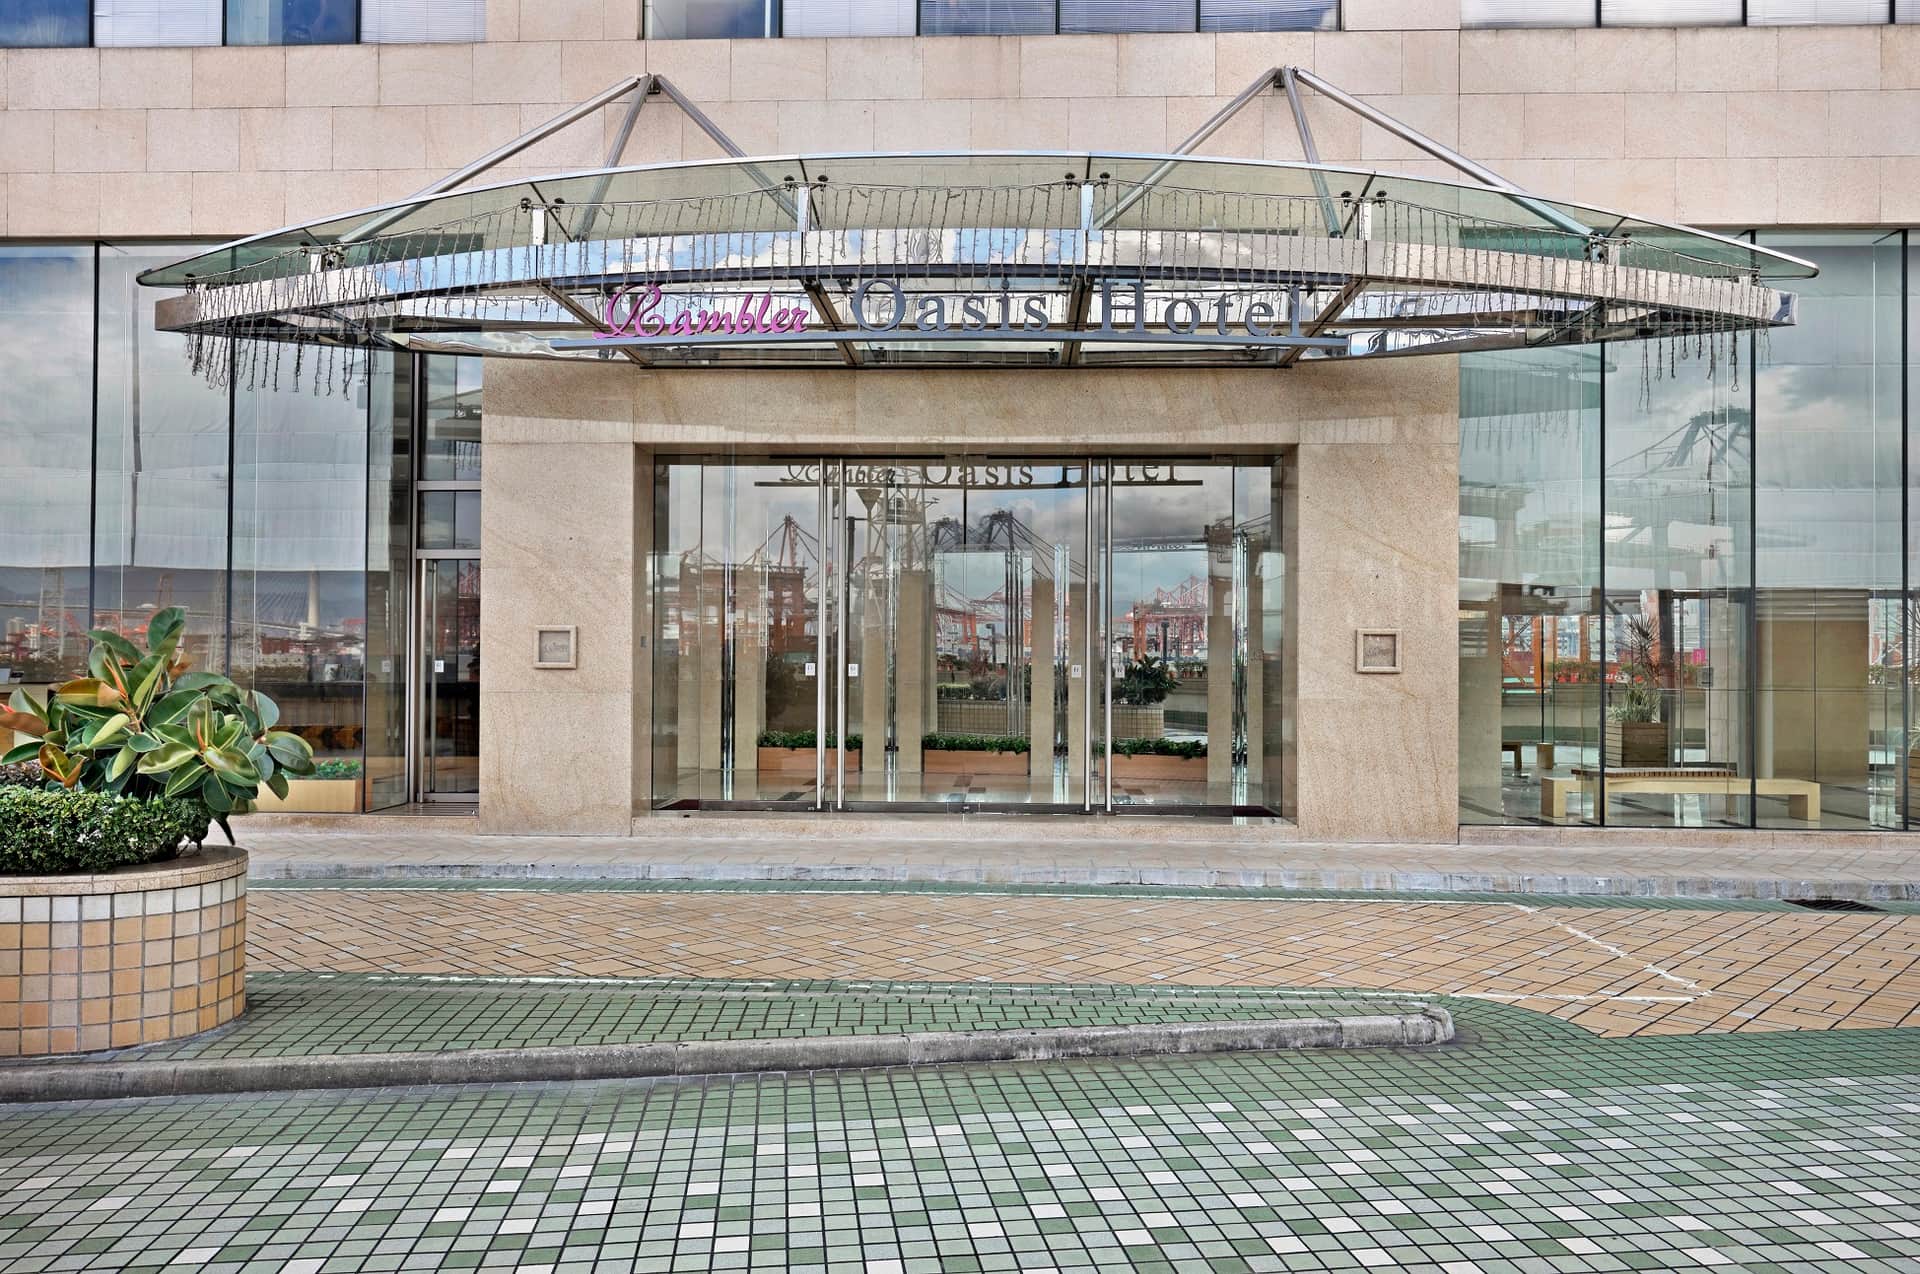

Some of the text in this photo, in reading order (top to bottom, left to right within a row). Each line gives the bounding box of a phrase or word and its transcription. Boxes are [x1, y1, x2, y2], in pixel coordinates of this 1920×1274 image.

[592, 277, 1302, 339] Rambler Oasis Hotel
